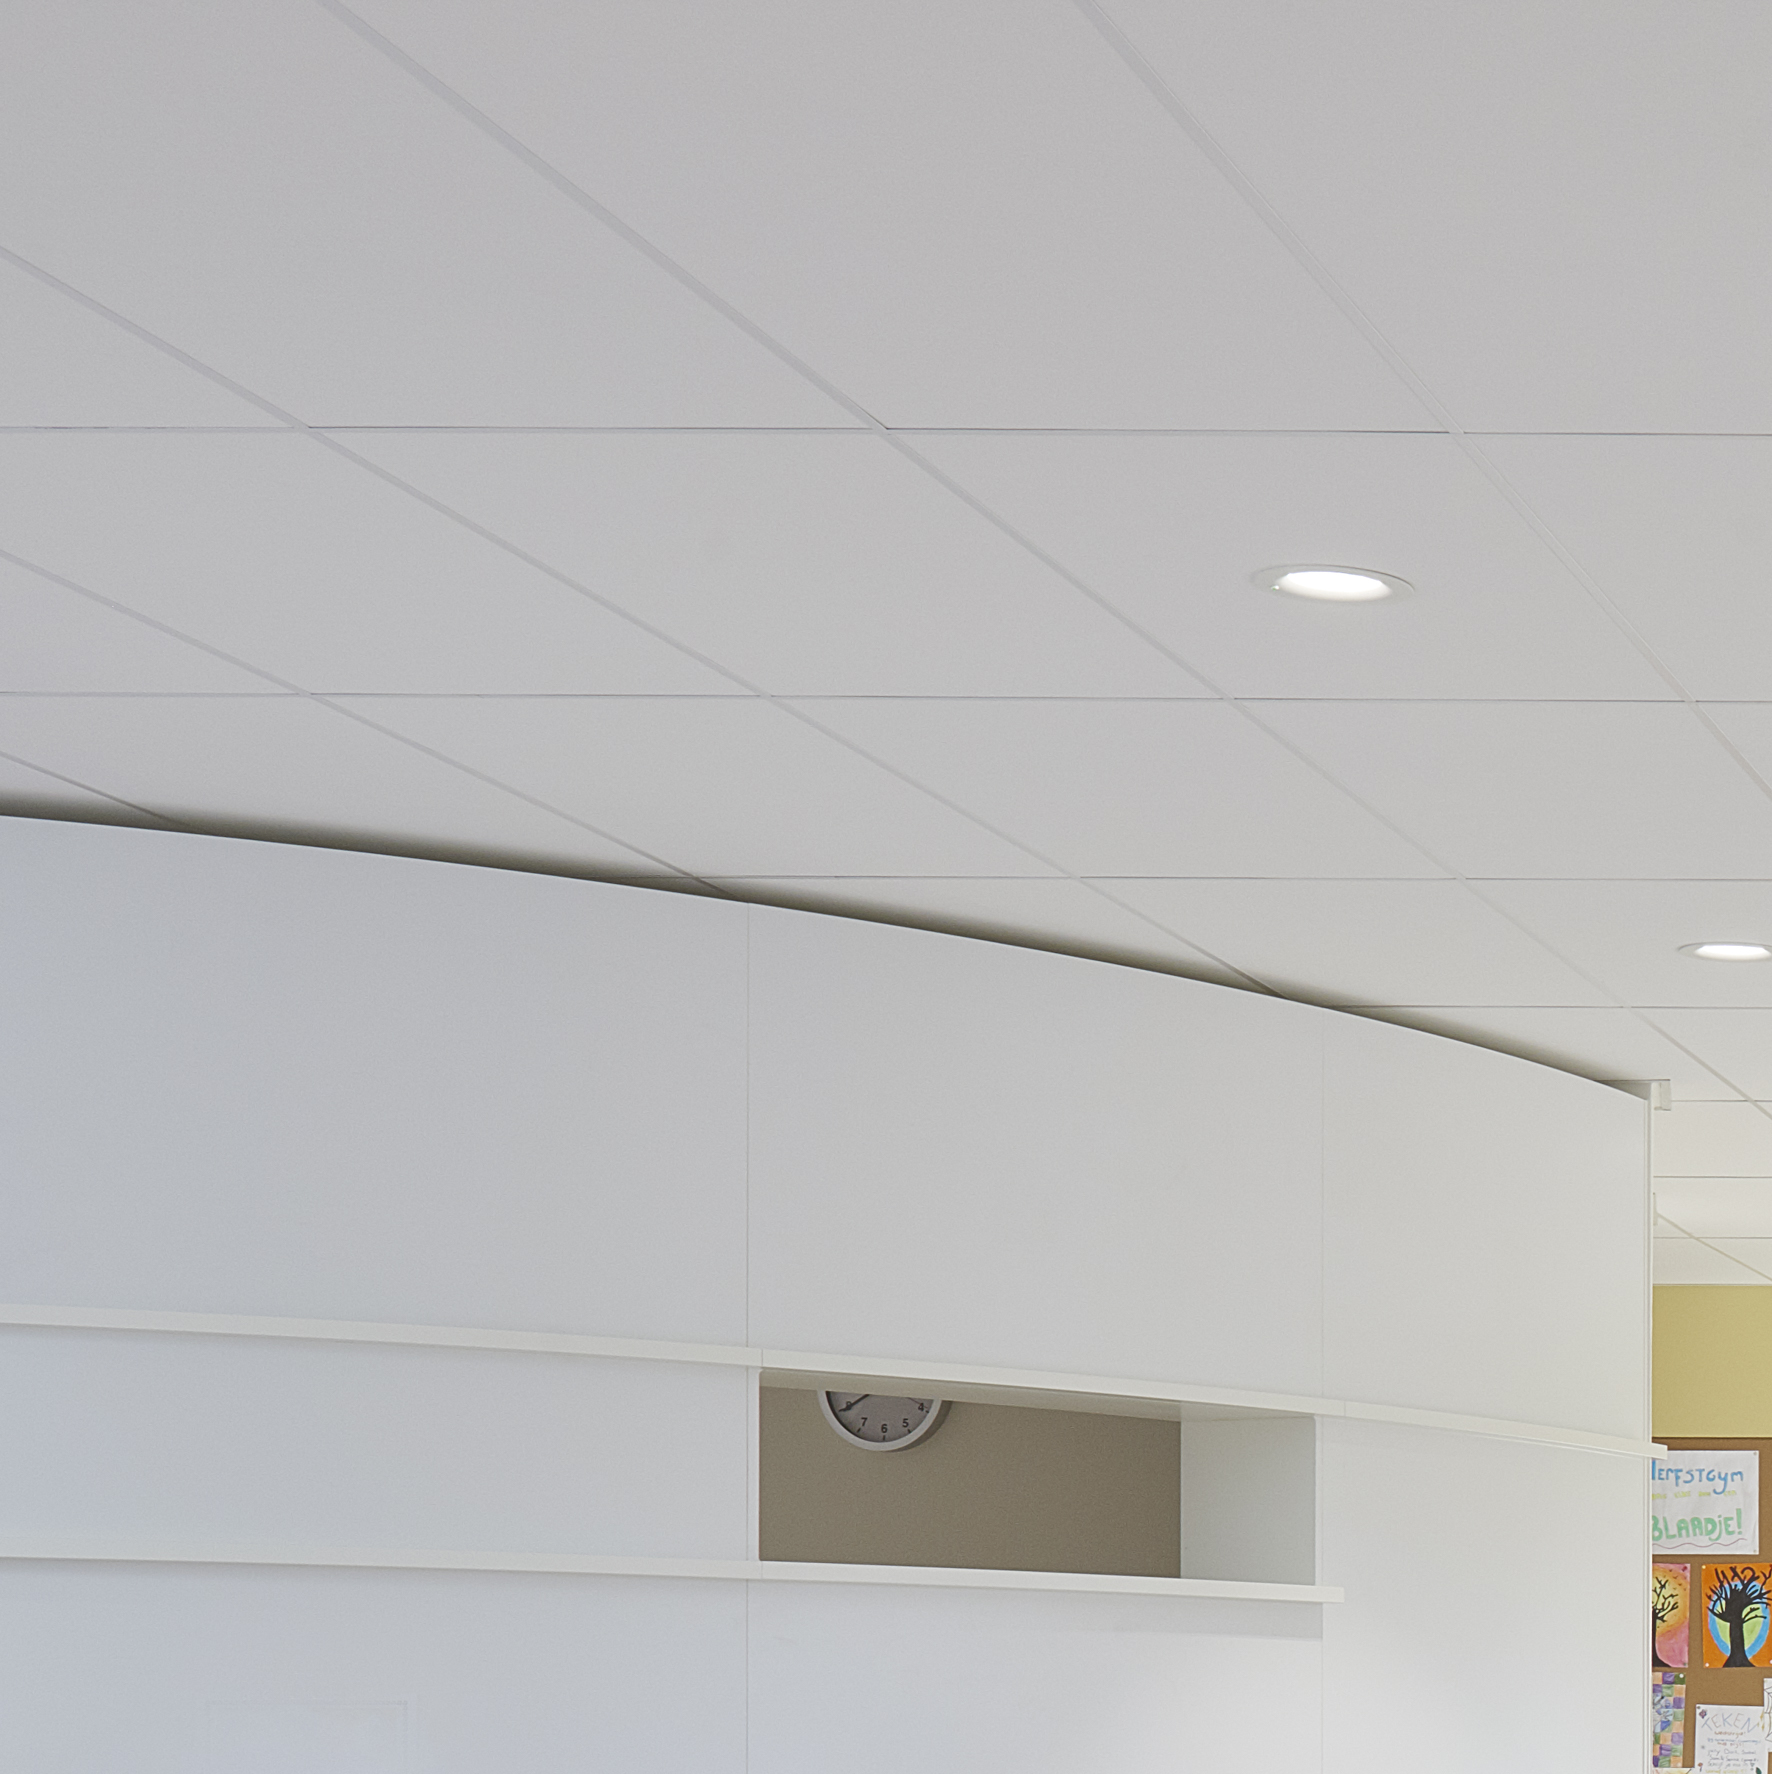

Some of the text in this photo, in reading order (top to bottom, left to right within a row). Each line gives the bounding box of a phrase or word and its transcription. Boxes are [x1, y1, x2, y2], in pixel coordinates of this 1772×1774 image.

[860, 1417, 869, 1427] 7
[902, 1418, 909, 1428] 5
[881, 1423, 888, 1434] 6
[1701, 1713, 1757, 1733] TEKEN
